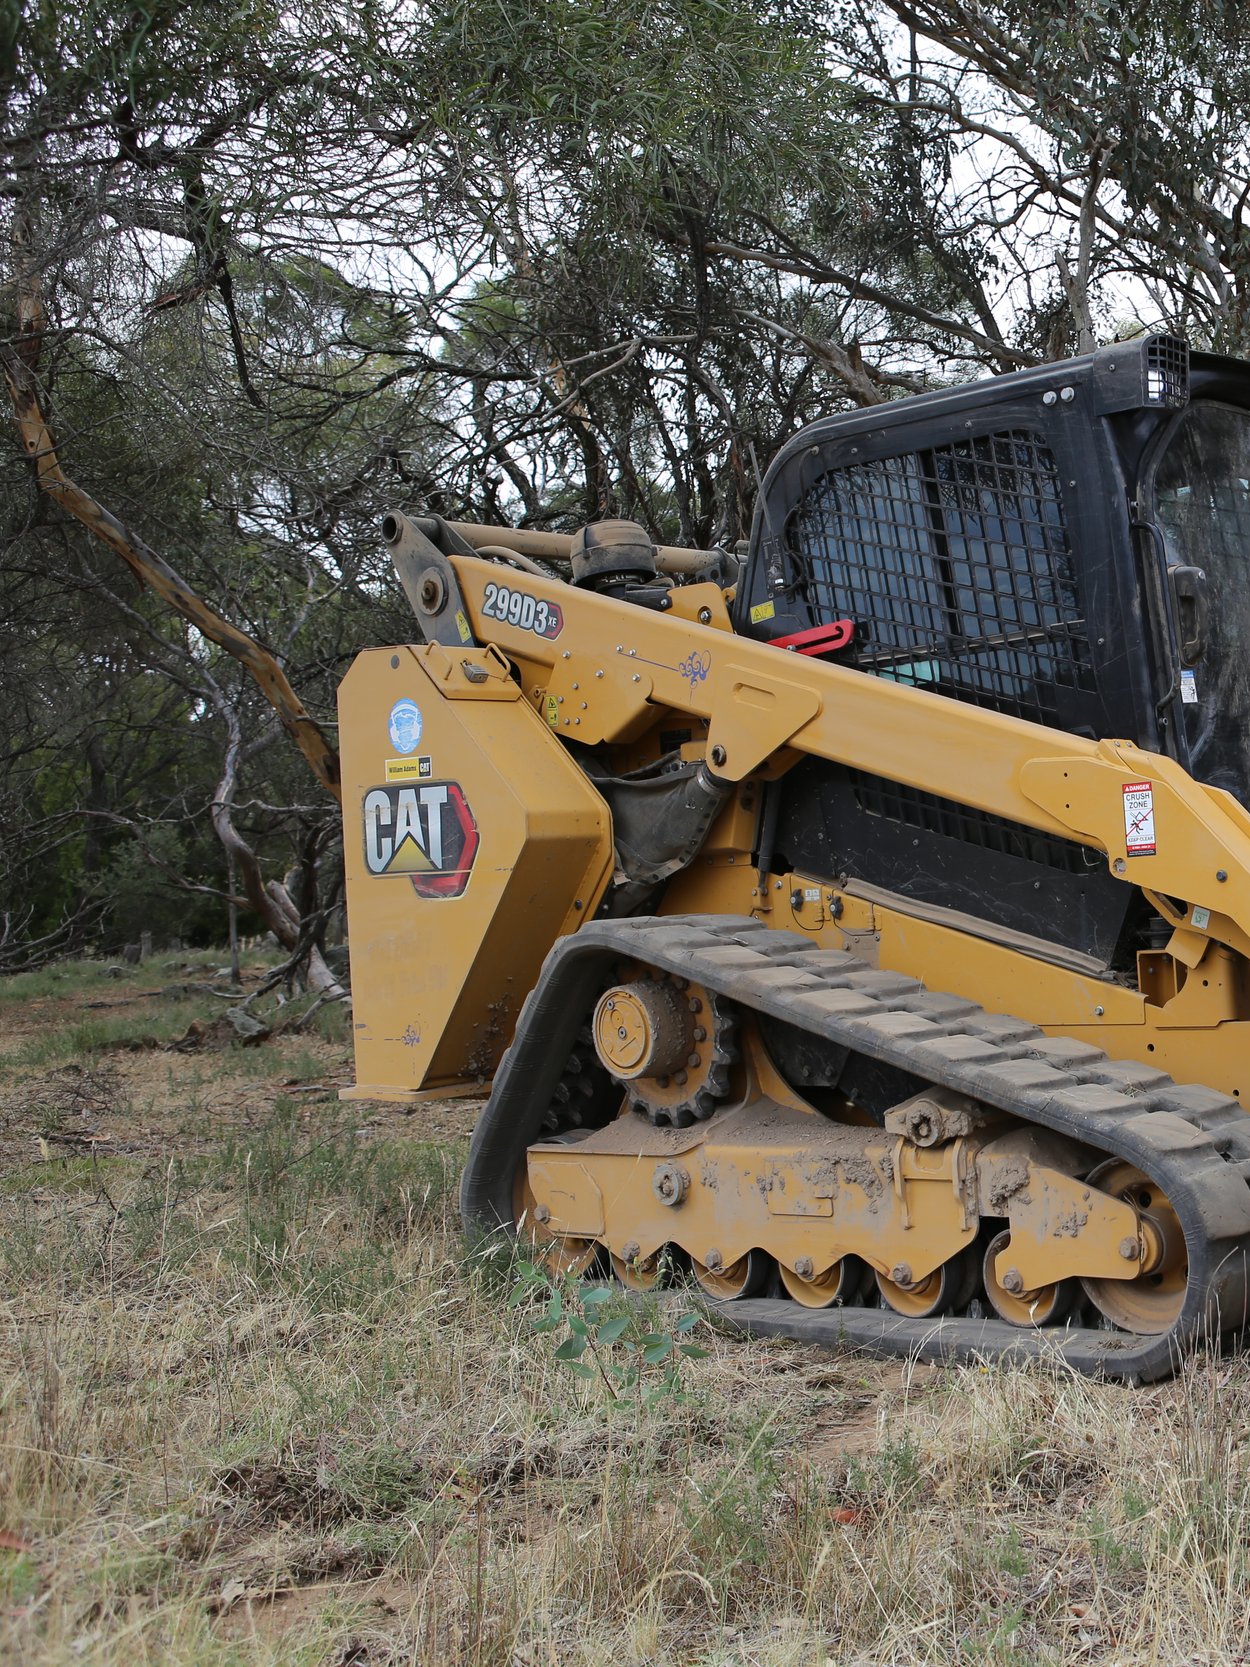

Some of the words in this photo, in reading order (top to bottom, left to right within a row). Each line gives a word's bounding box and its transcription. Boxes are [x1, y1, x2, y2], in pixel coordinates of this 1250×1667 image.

[483, 584, 548, 633] 299D3
[548, 616, 557, 627] XE
[420, 762, 430, 772] CAT
[1126, 793, 1150, 801] CRUSH
[1129, 801, 1147, 809] ZONE
[364, 786, 447, 872] CAT
